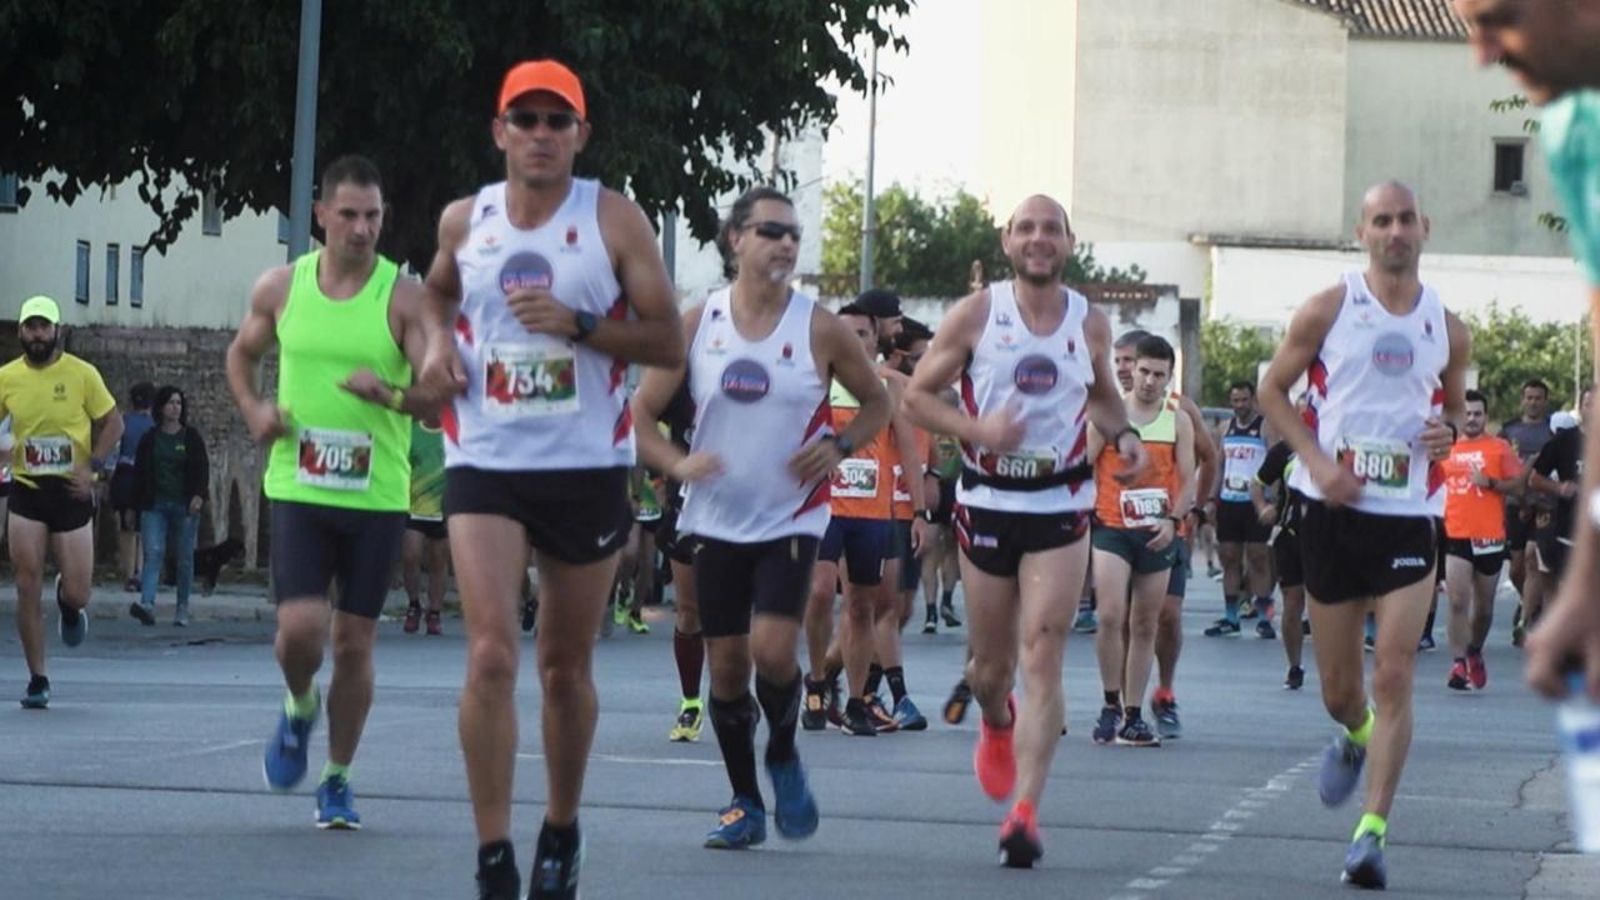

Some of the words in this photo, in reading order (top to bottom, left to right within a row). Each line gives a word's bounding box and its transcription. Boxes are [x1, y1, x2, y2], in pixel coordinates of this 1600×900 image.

[504, 363, 553, 395] 734
[314, 445, 353, 471] 705
[996, 456, 1037, 478] 660
[1353, 452, 1394, 479] 680
[840, 468, 868, 484] 304
[1133, 498, 1161, 514] 1189
